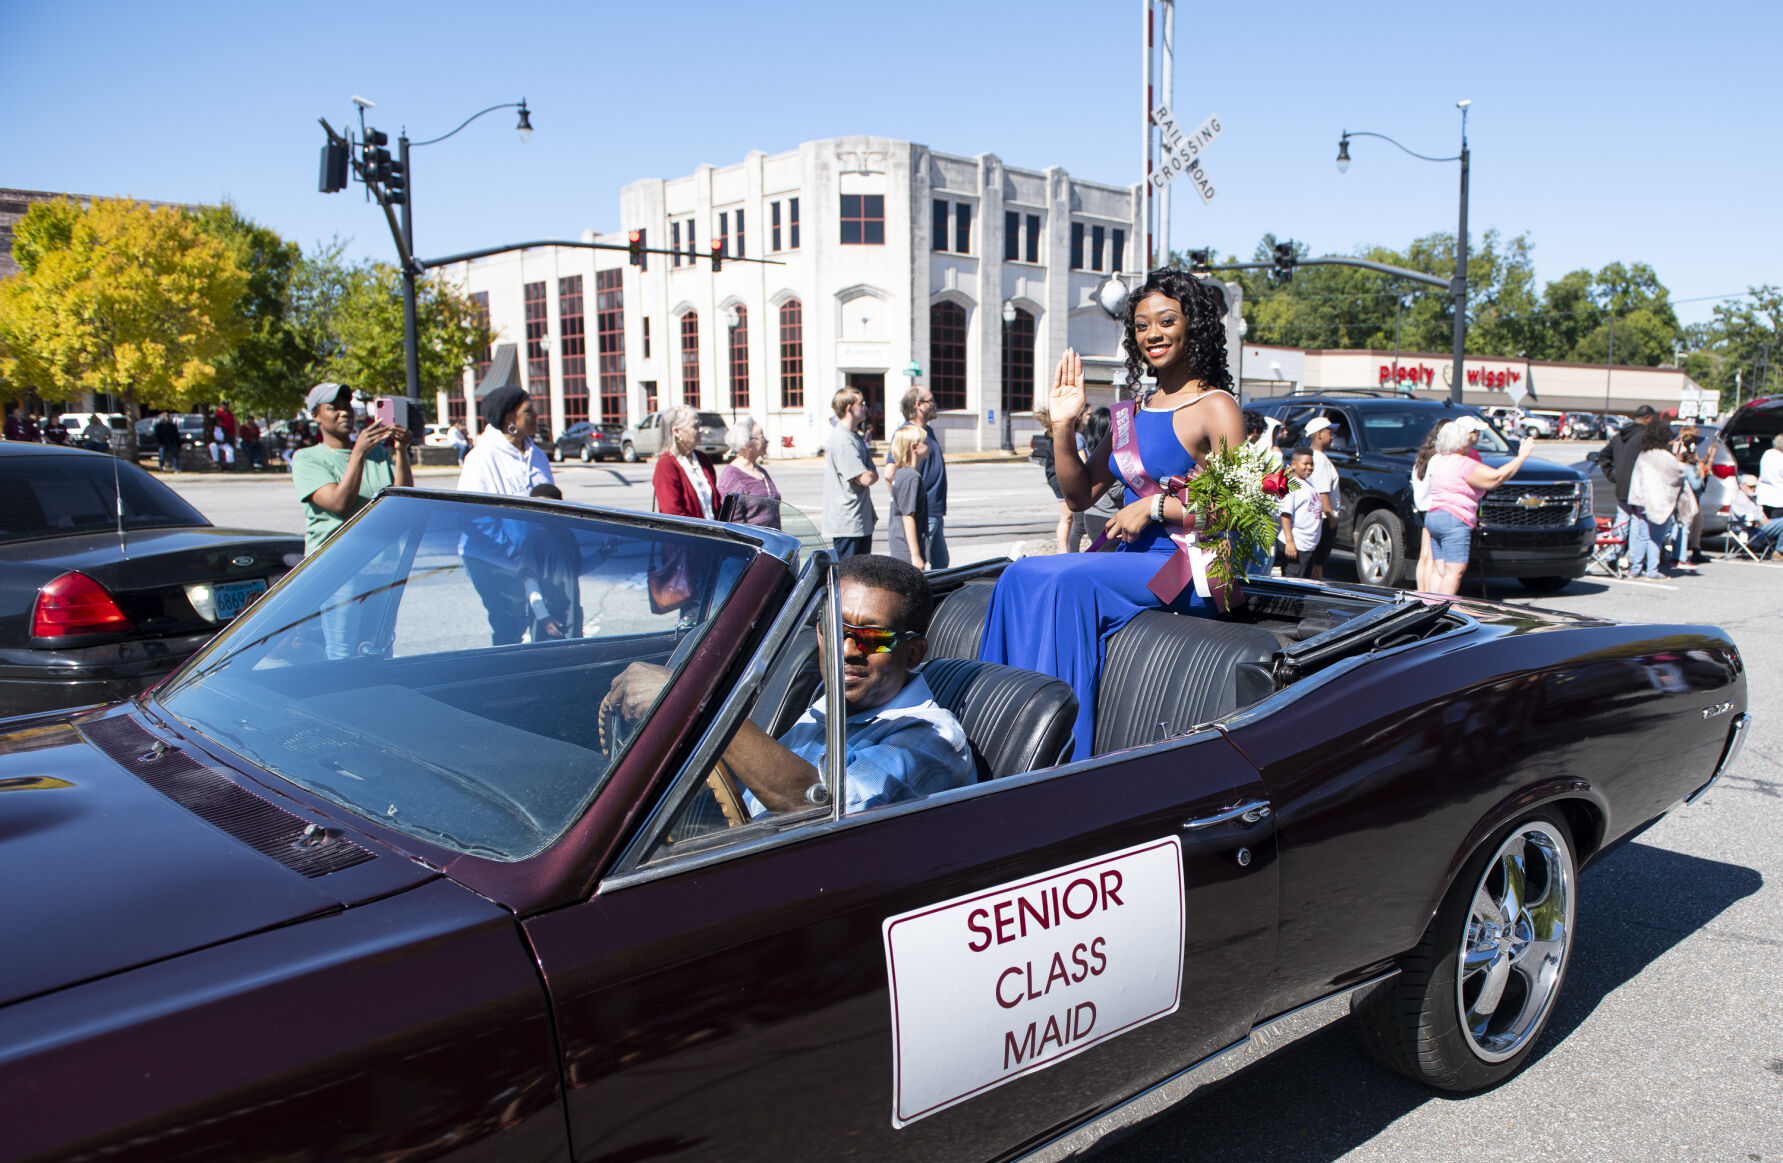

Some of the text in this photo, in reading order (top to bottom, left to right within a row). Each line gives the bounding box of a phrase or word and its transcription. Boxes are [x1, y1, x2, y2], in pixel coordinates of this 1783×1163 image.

[1153, 118, 1221, 188] CROSSING
[1156, 106, 1215, 199] RAIL ROAD
[1379, 361, 1434, 385] piggly
[967, 869, 1125, 953] SENIOR
[995, 936, 1107, 1009] CLASS
[1003, 1001, 1097, 1070] MAID
